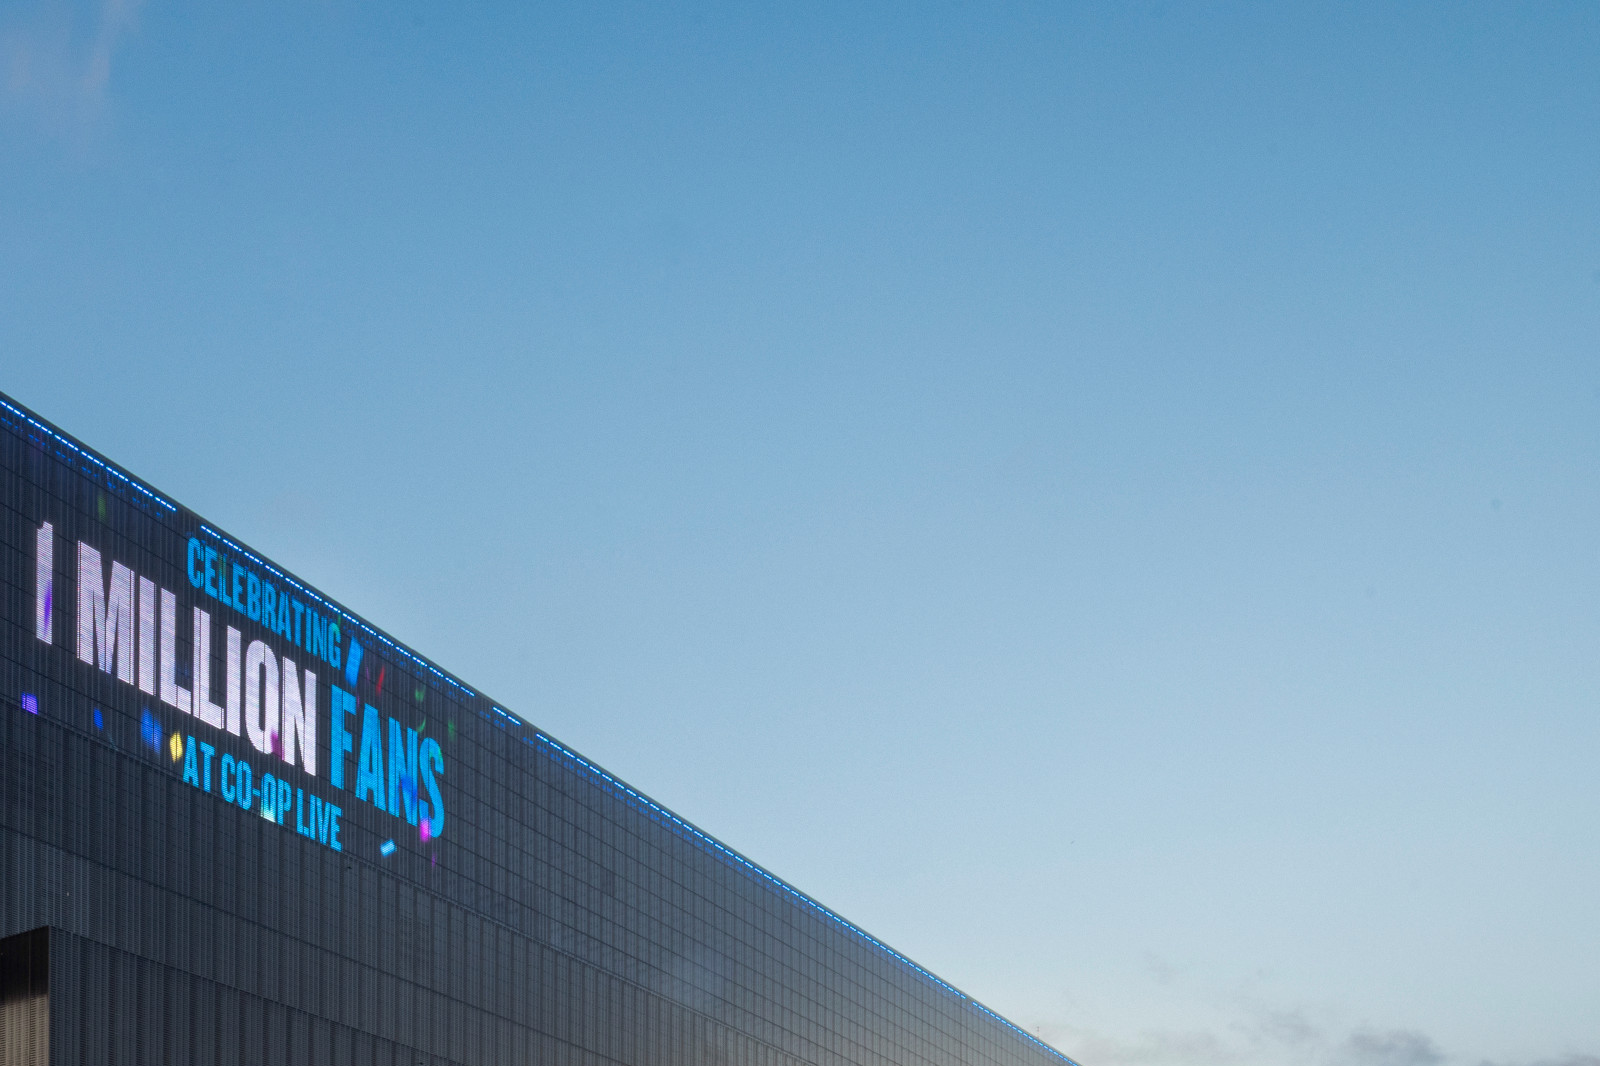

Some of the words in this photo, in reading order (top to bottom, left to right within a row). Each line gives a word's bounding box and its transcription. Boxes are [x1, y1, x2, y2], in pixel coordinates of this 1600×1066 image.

[187, 536, 341, 670] CELEBRATING
[77, 540, 316, 777] MILLION
[330, 684, 444, 838] FANS
[182, 734, 216, 793] AT
[220, 752, 292, 826] CO-OP
[296, 787, 343, 852] LIVE
